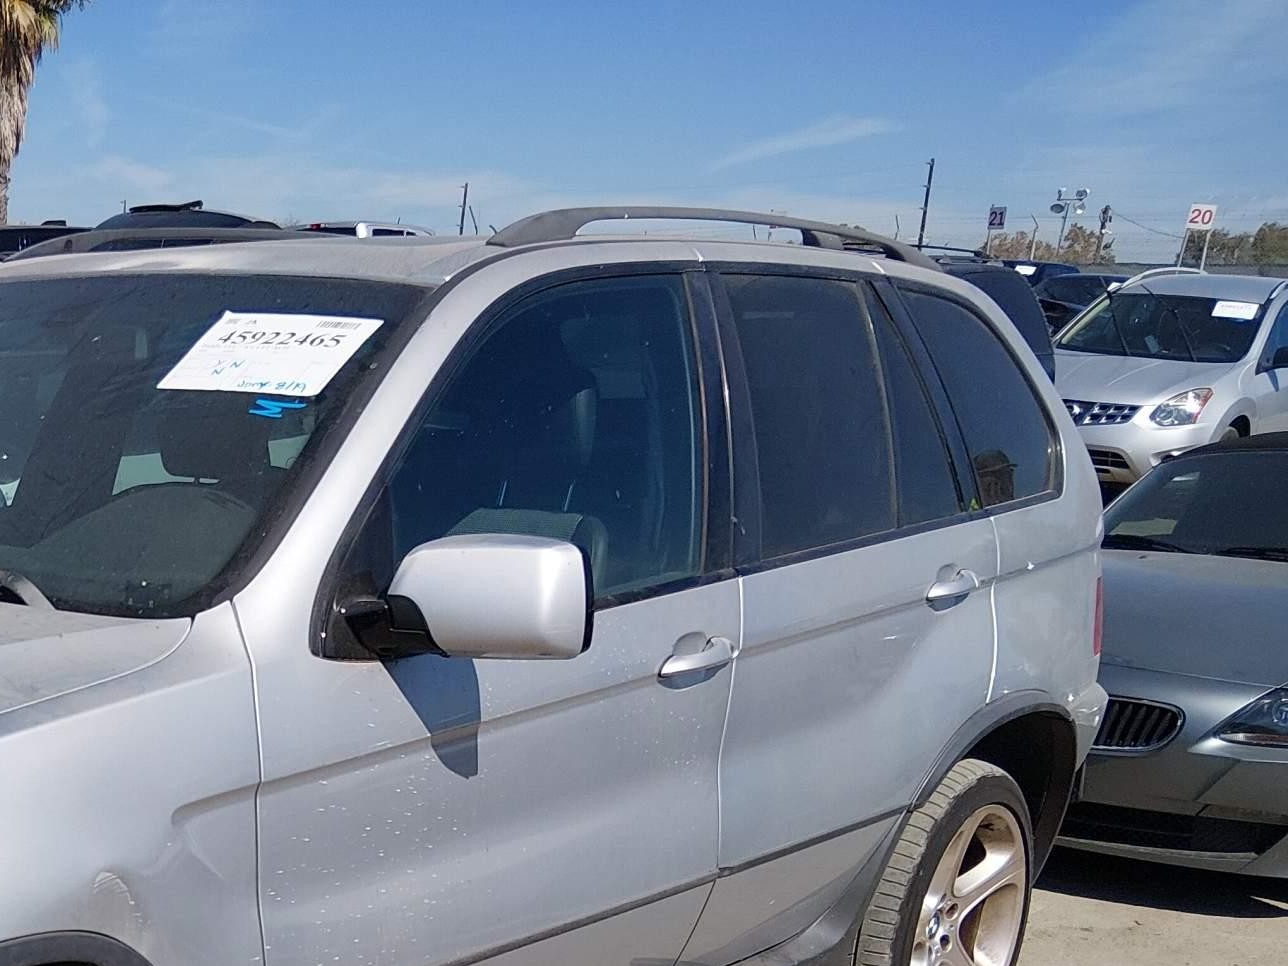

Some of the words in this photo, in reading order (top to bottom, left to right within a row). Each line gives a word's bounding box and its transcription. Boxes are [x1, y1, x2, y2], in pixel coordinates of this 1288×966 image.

[988, 210, 1005, 226] 21
[1188, 208, 1214, 225] 20
[218, 330, 347, 347] 45922465
